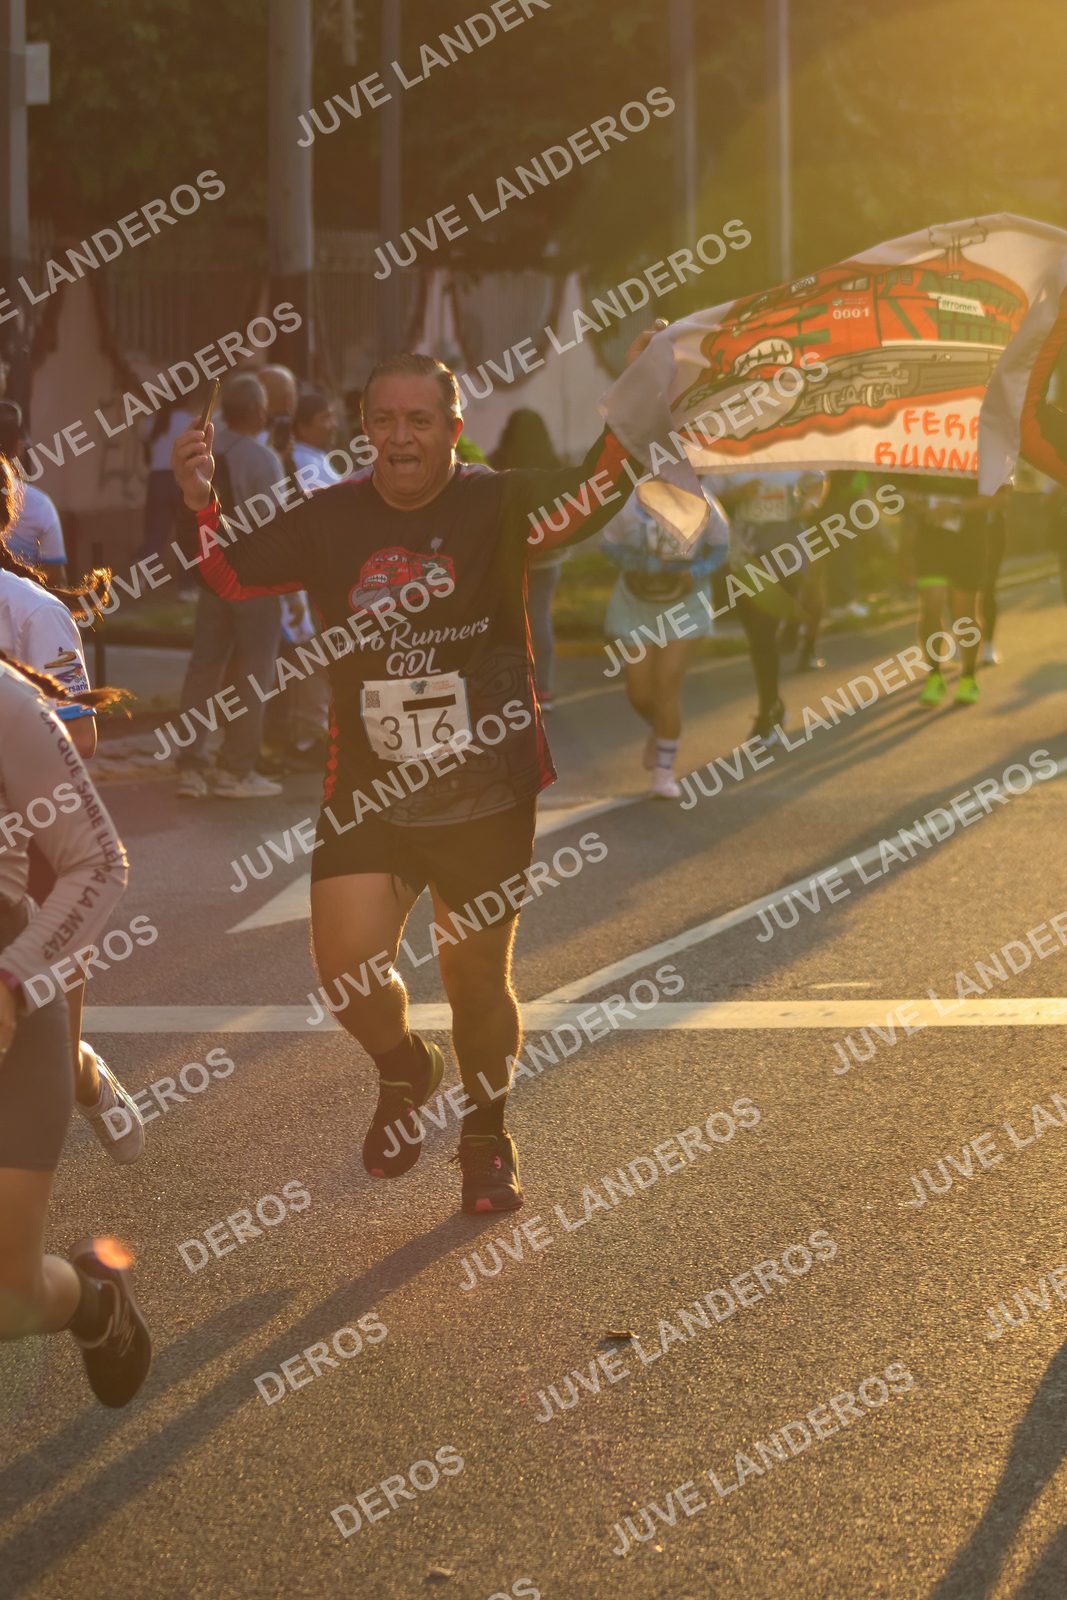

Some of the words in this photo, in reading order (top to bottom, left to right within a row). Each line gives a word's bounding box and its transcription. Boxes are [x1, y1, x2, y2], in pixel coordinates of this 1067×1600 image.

[832, 307, 870, 320] 0001
[390, 616, 489, 650] Runners
[386, 648, 441, 676] GDL
[380, 710, 454, 751] 316
